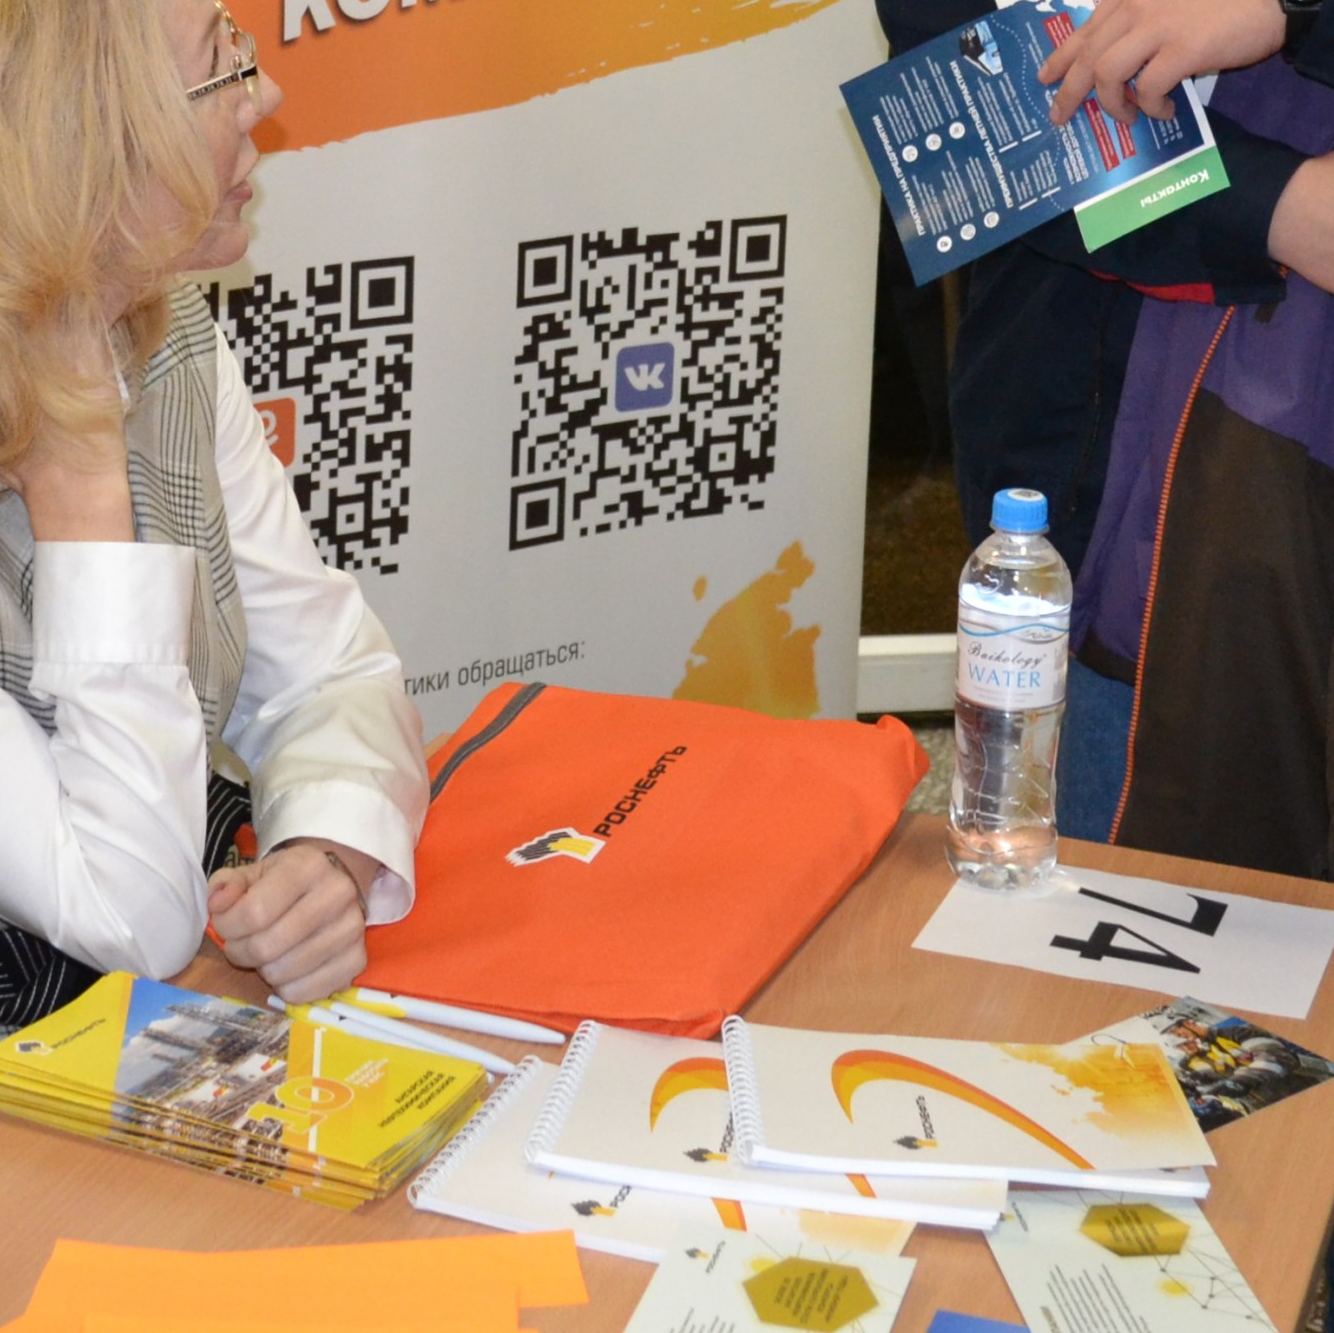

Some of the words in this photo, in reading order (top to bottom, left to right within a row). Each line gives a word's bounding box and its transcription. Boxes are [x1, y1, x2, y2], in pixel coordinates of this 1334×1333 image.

[1140, 169, 1209, 208] Контакты
[404, 672, 450, 696] тики
[457, 640, 586, 687] обращаться:
[969, 663, 1041, 688] WATER
[593, 745, 687, 838] РОСНЕФТЬ
[1049, 886, 1228, 974] 74
